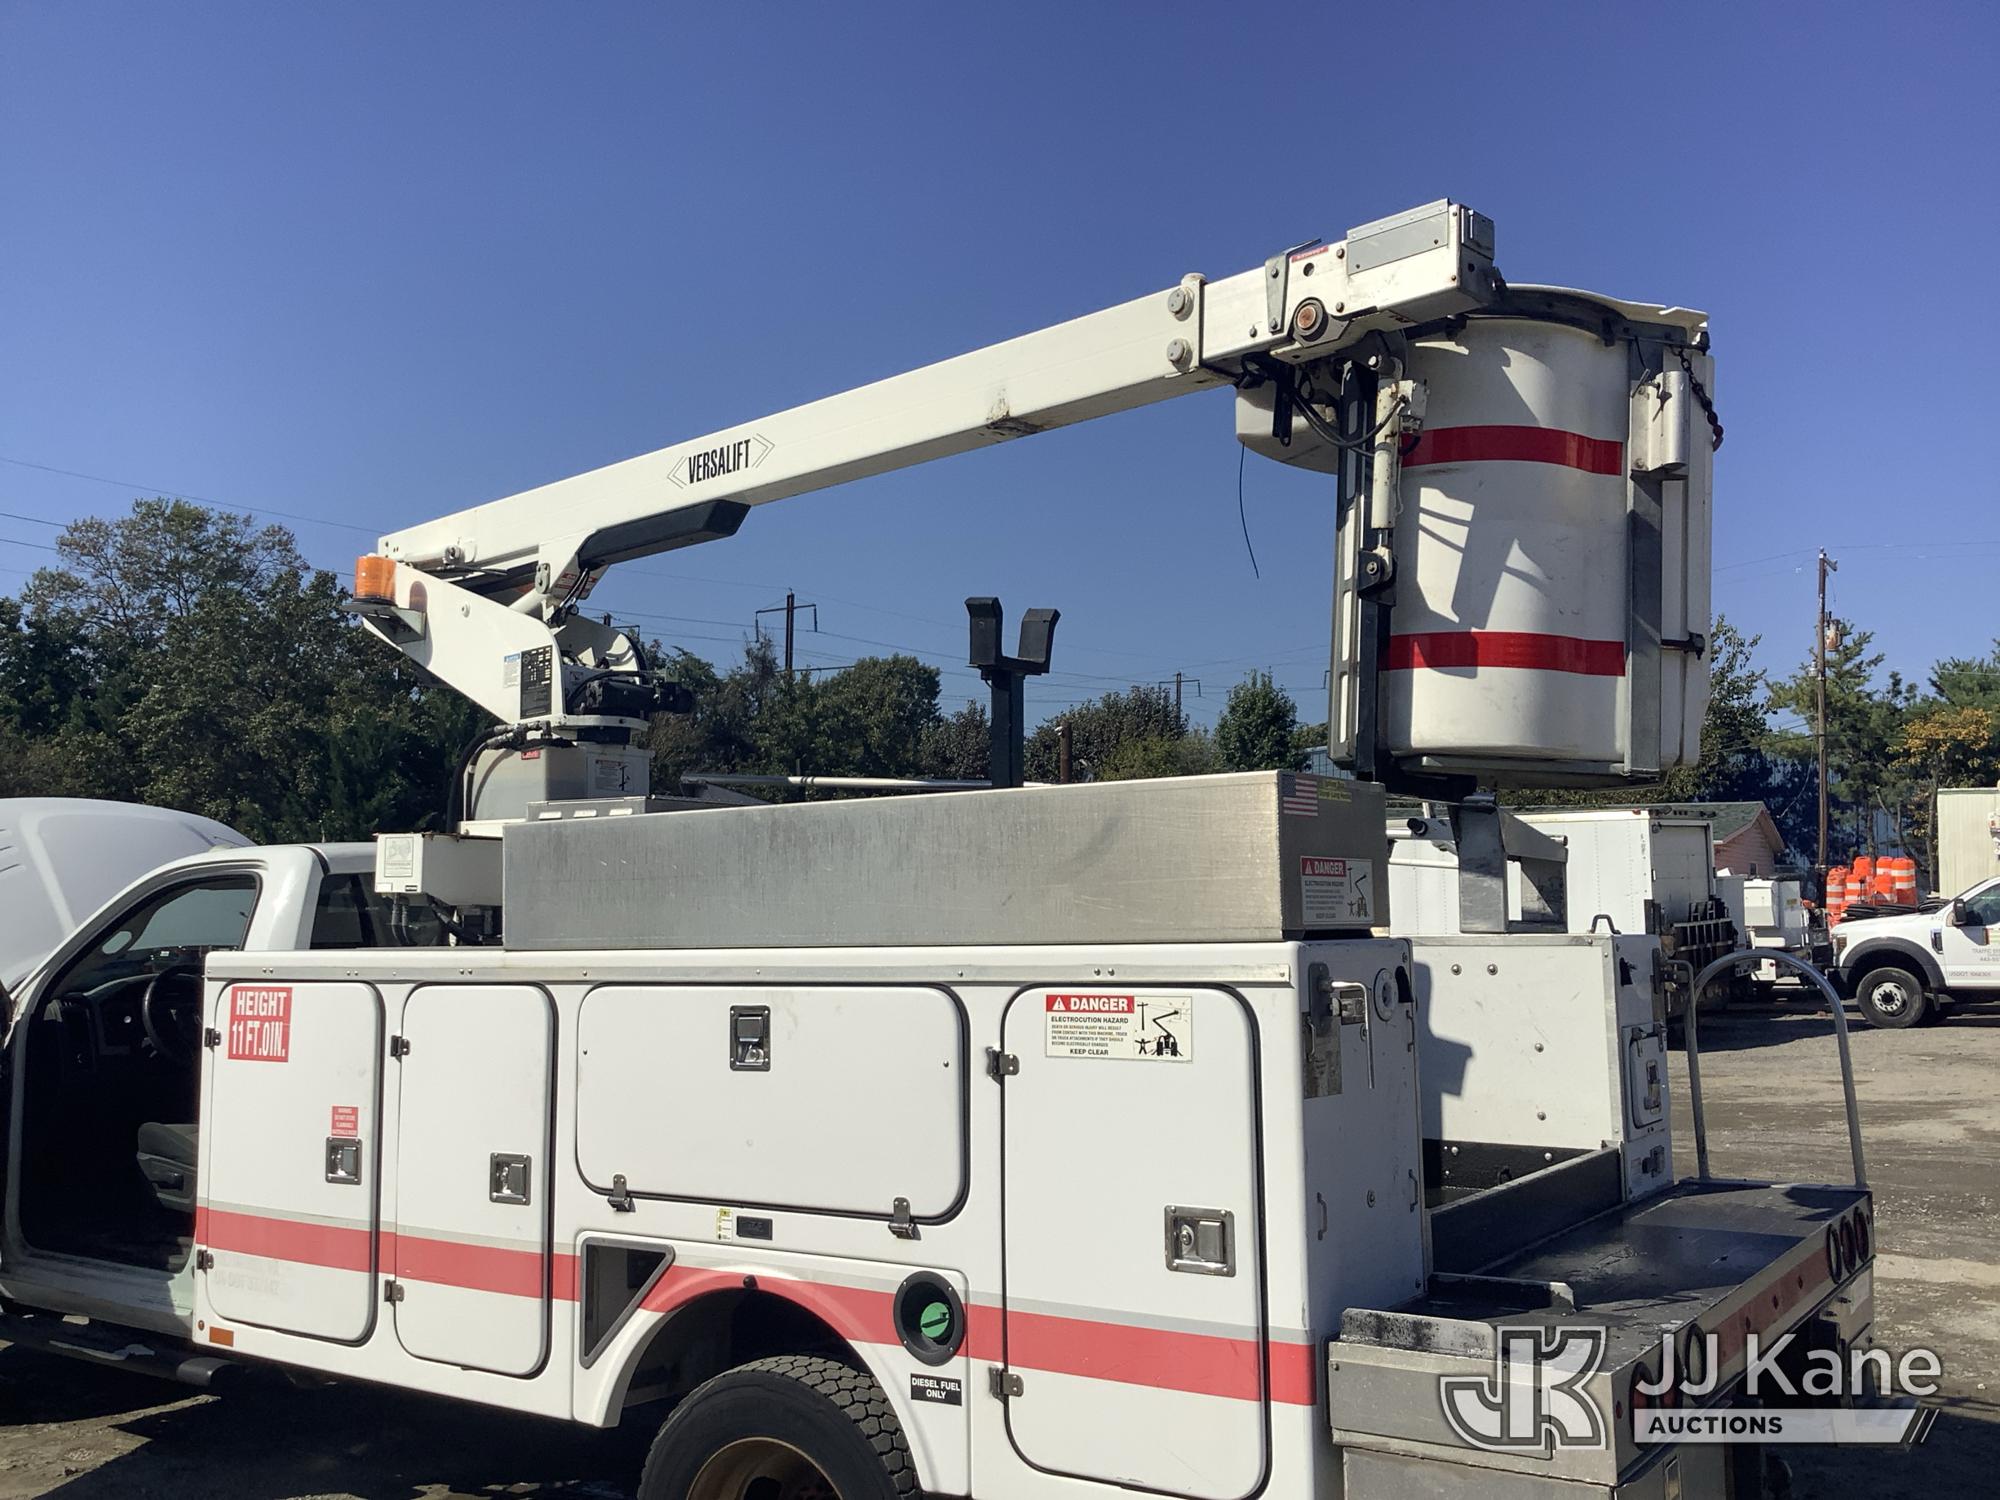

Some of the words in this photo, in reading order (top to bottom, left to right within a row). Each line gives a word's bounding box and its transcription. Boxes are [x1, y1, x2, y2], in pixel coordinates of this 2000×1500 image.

[688, 438, 751, 484] VERSALIFT
[1314, 861, 1344, 875] DANGER
[236, 991, 287, 1017] HEIGHT
[1070, 996, 1128, 1012] DANGER
[1103, 1016, 1129, 1024] HAZARD
[911, 1377, 939, 1389] DIESEL
[940, 1380, 961, 1391] FUEL
[926, 1389, 947, 1399] ONLY
